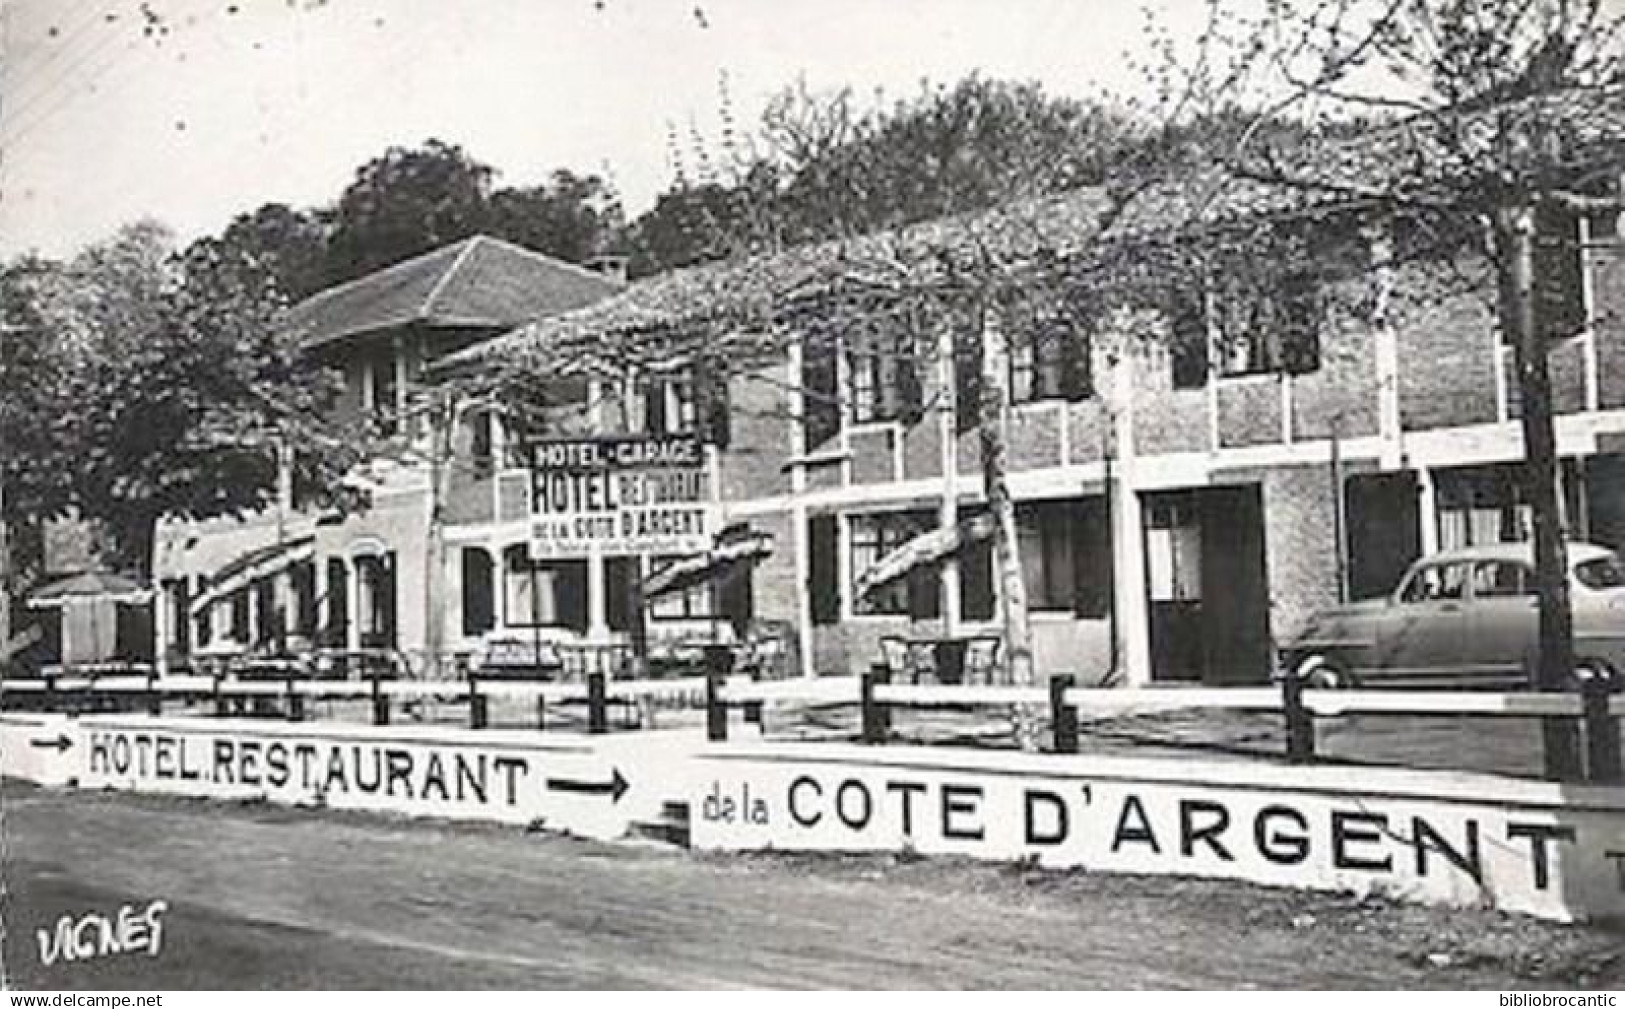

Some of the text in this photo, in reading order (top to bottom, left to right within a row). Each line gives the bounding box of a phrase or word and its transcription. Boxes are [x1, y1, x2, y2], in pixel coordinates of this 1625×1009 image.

[534, 439, 701, 466] HOTEL GARAGE
[532, 469, 617, 513] HOTEL
[703, 775, 1577, 890] de la COTE D'ARGENT
